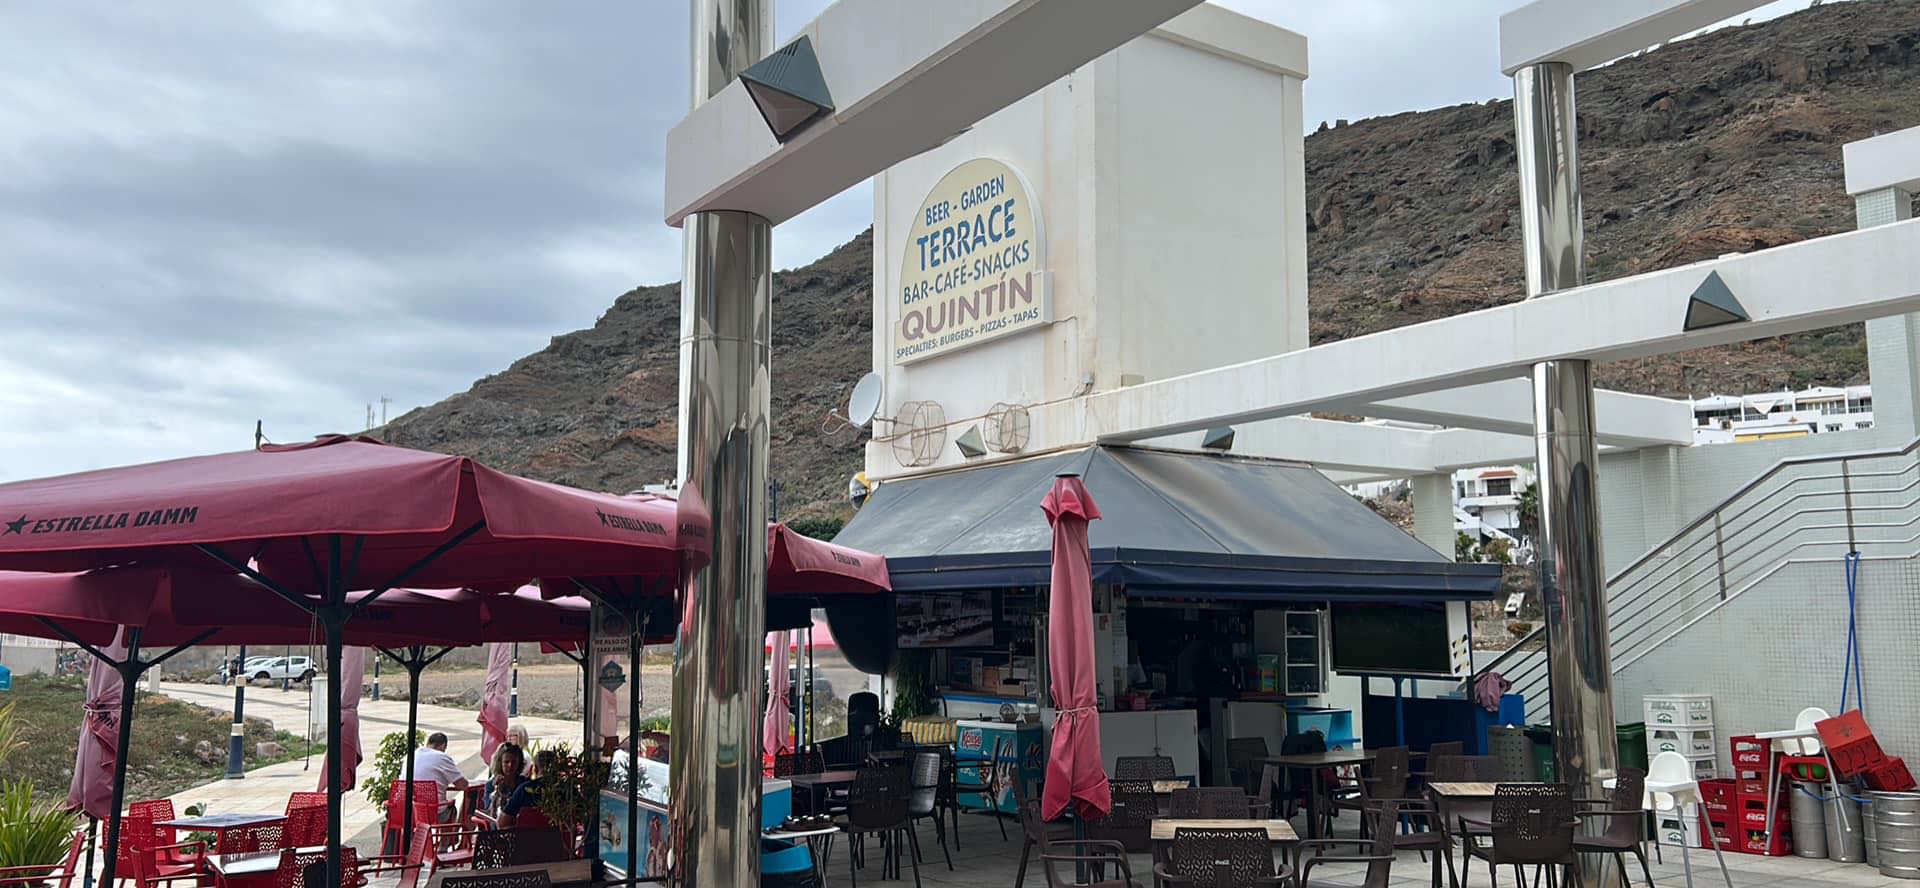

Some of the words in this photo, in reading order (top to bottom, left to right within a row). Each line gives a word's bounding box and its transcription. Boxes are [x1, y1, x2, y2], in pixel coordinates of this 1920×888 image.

[926, 200, 950, 227] BEER
[961, 174, 1005, 211] GARDEN
[916, 198, 1016, 272] TERRACE
[902, 271, 1033, 341] QUINTÍN
[896, 340, 939, 359] SPECIALTIES:
[940, 328, 974, 346] BURGERS
[980, 316, 1007, 335] PIZZAS
[1013, 307, 1039, 325] TAPAS
[31, 512, 130, 534] ESTRELLA
[133, 506, 199, 528] DAMM
